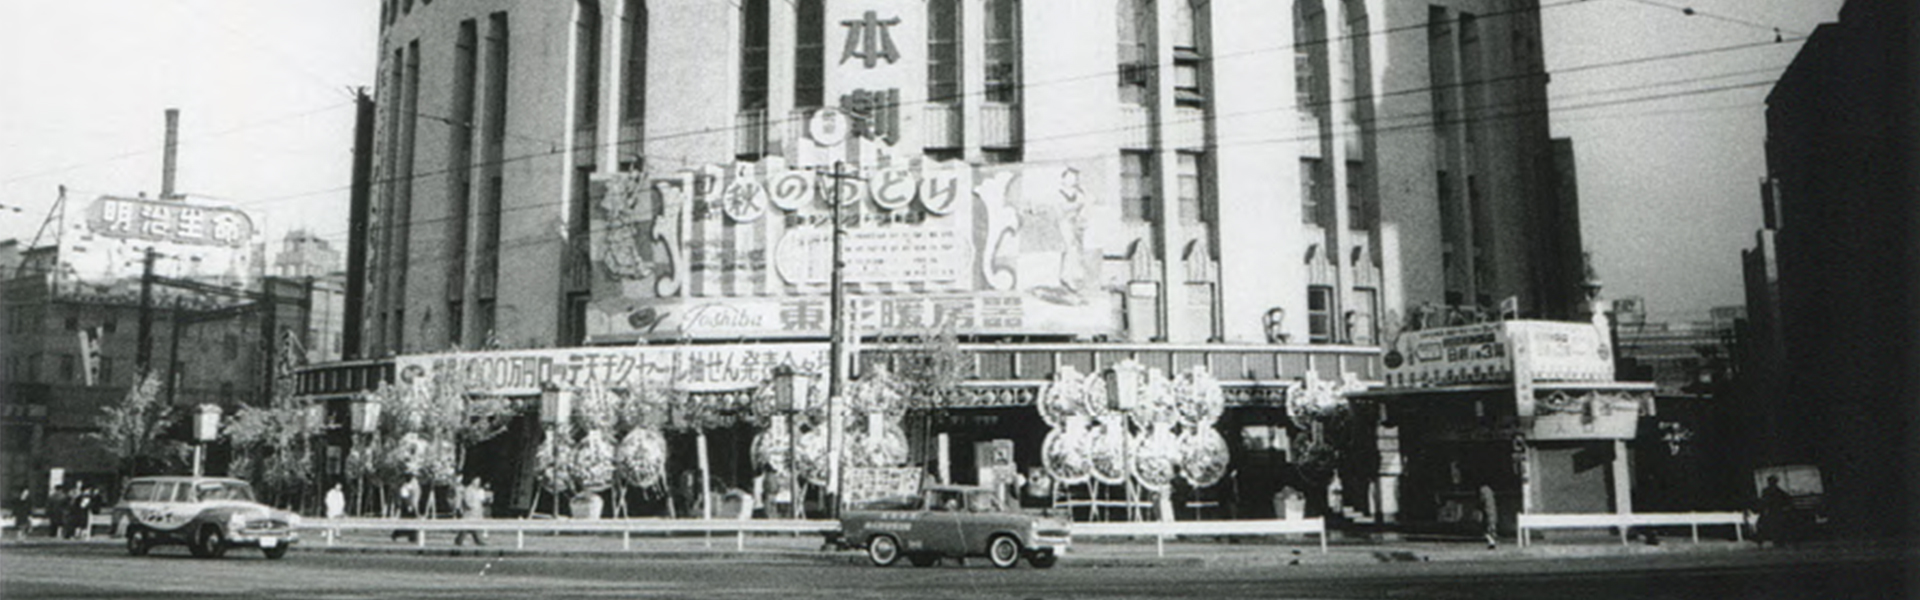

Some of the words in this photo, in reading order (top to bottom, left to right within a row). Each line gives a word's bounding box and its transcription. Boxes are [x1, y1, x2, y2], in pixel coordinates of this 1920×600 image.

[103, 200, 241, 243] 明治生命
[677, 302, 763, 332] Toshiba
